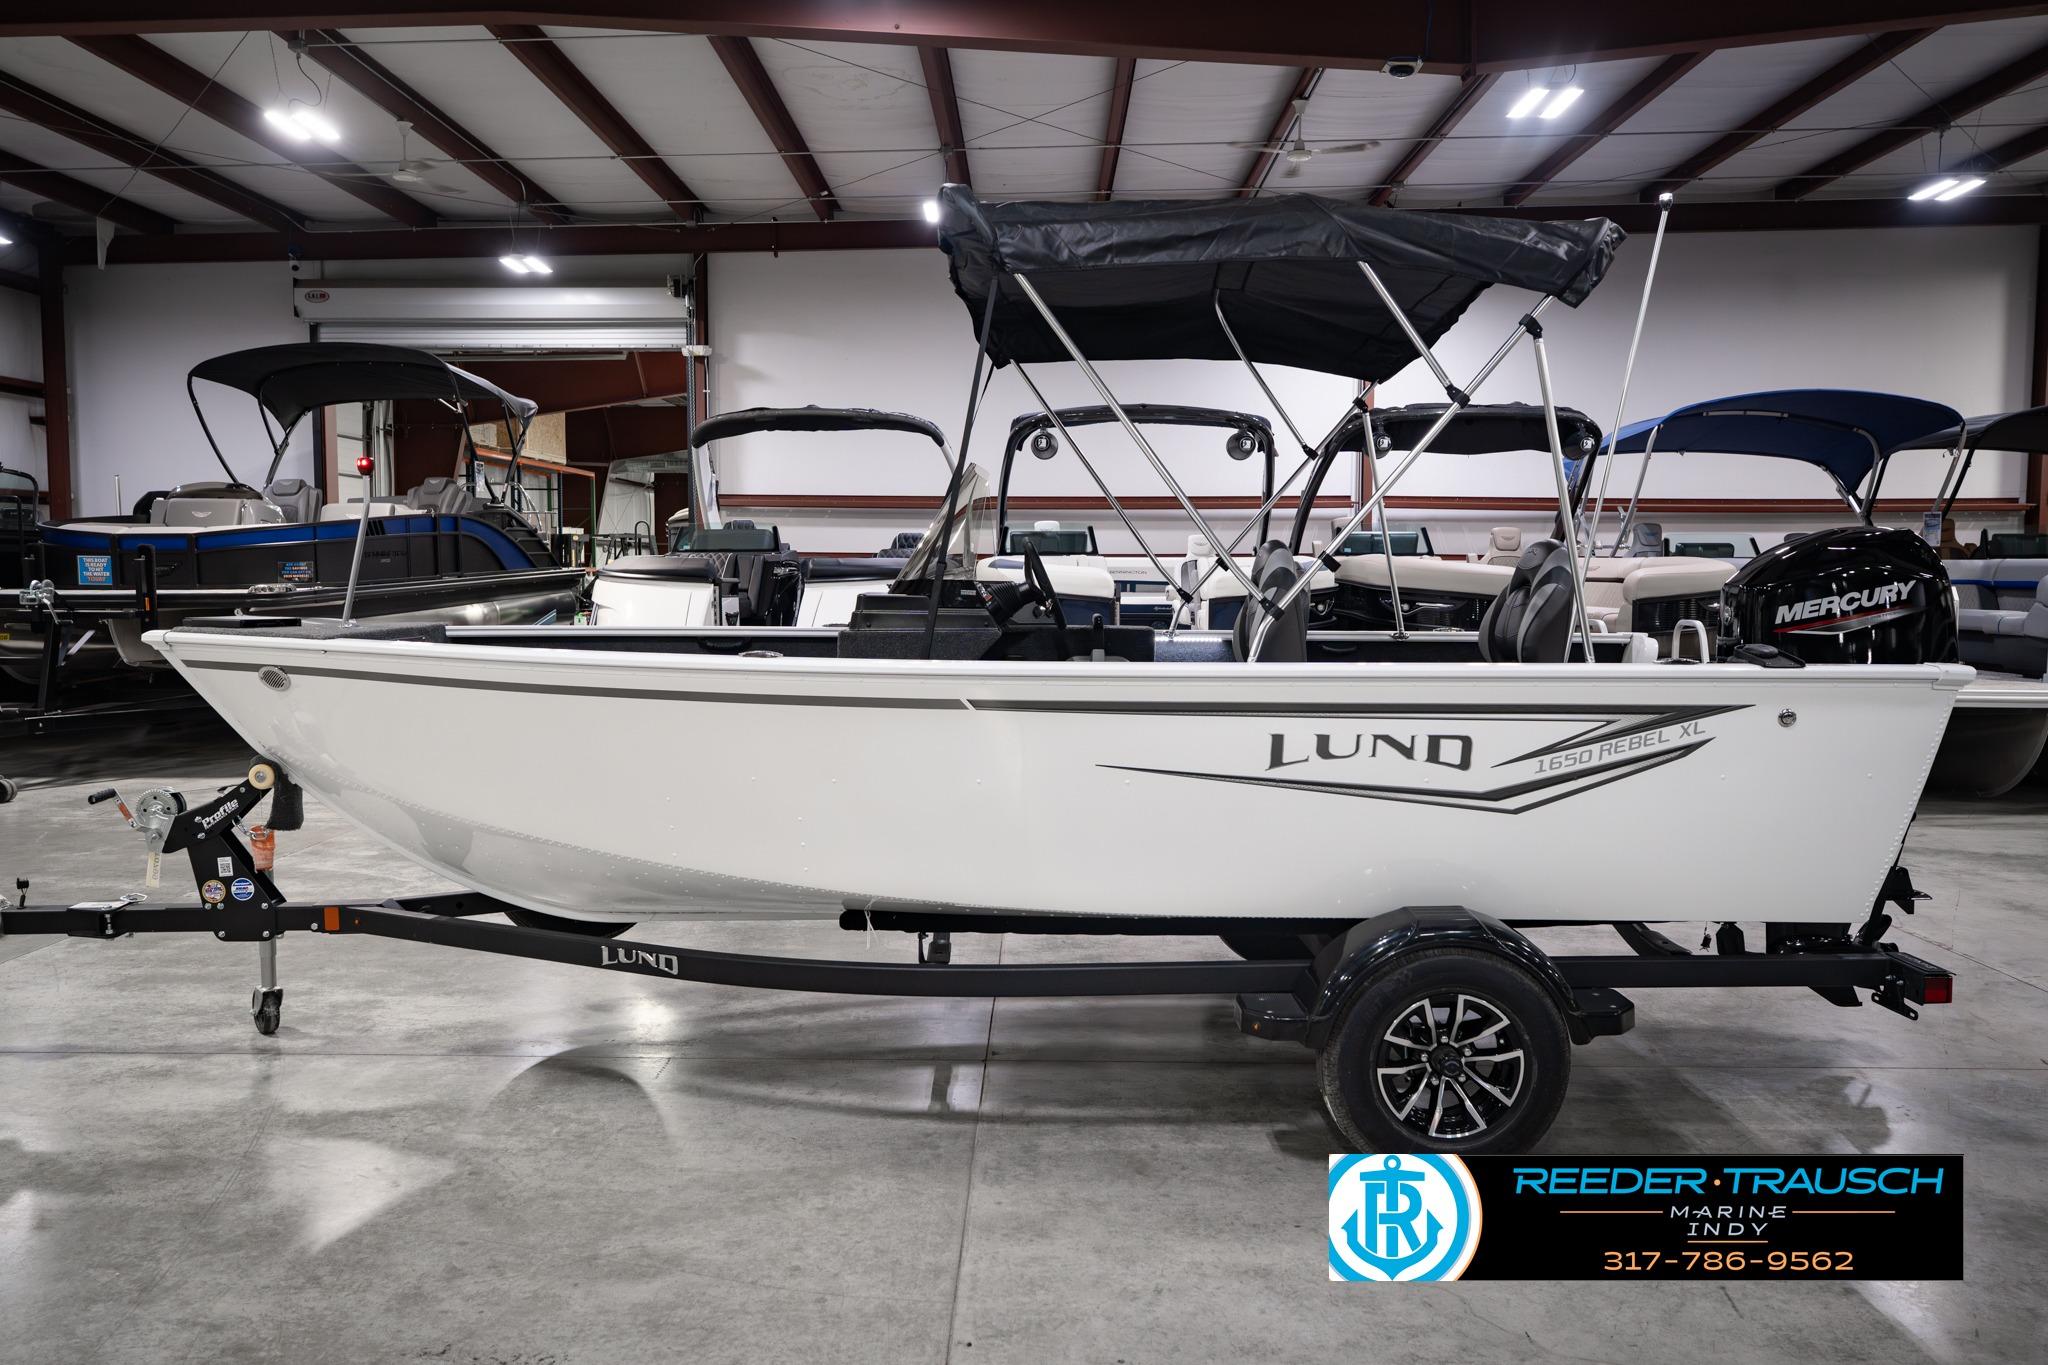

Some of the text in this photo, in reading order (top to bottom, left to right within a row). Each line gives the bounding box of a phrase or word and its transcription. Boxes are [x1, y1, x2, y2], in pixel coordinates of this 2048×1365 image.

[1774, 579, 1917, 625] MERCURY
[1265, 733, 1473, 771] LUND
[1534, 721, 1706, 774] 1650 REBEL XL
[201, 799, 239, 830] Profile
[600, 945, 679, 976] LUND
